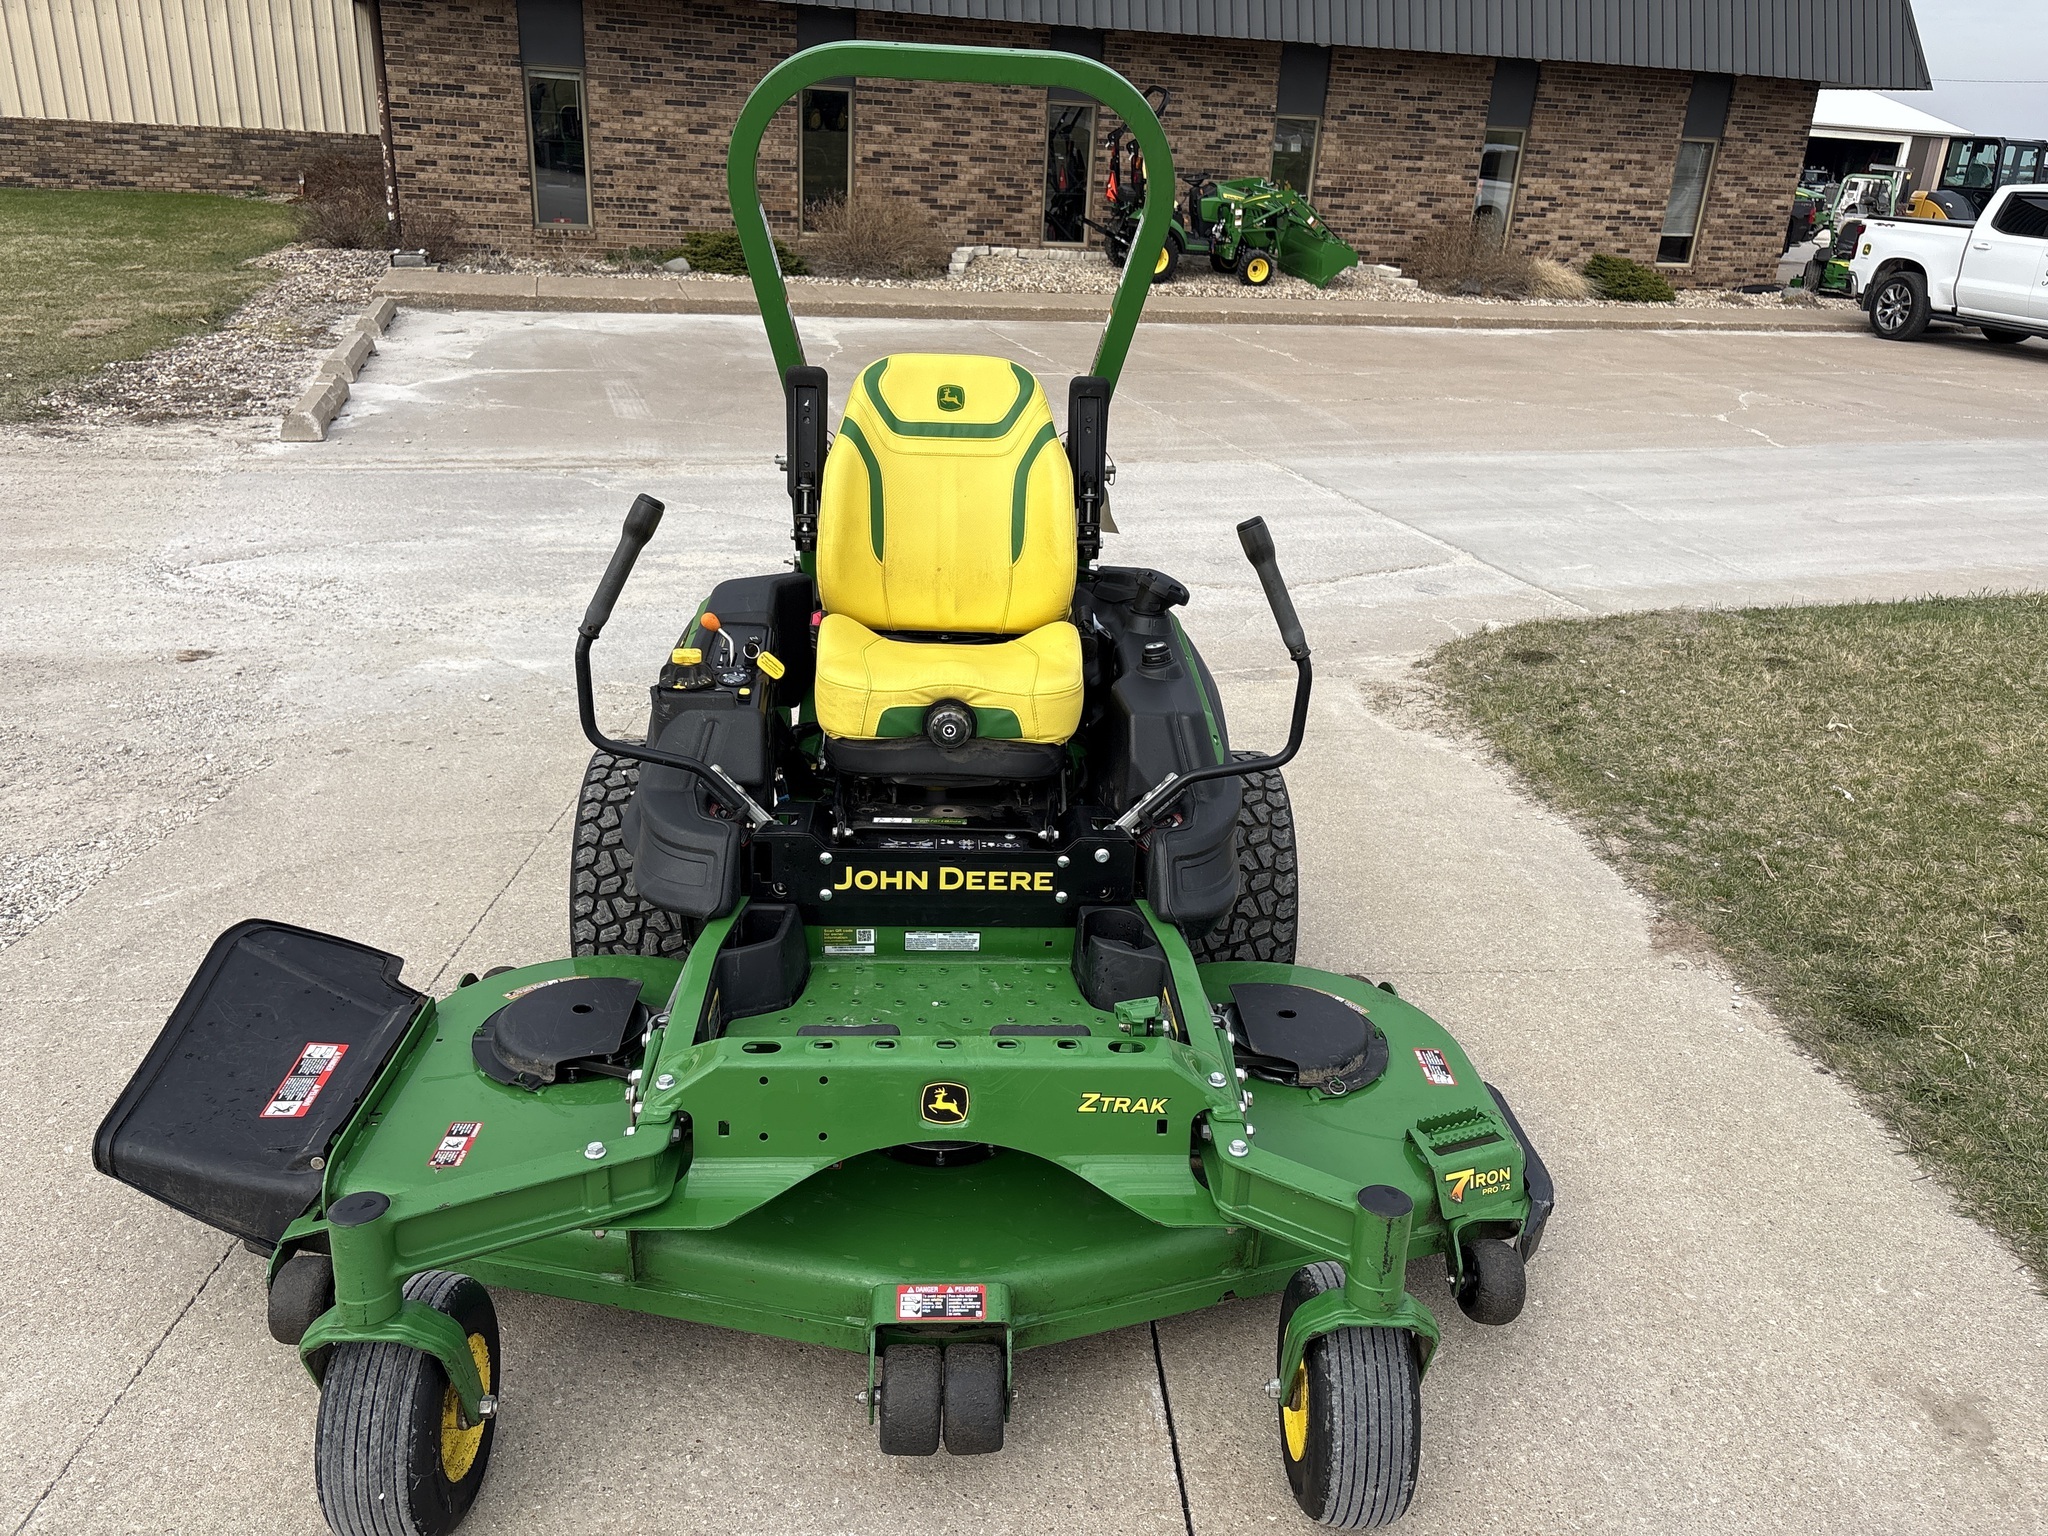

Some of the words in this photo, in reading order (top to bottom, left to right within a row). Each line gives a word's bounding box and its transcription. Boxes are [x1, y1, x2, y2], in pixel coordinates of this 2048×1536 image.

[834, 866, 928, 891] JOHN
[939, 866, 1054, 891] DEERE
[1078, 1093, 1170, 1114] ZTRAK
[1482, 1186, 1499, 1196] PRO
[1501, 1183, 1511, 1192] 72
